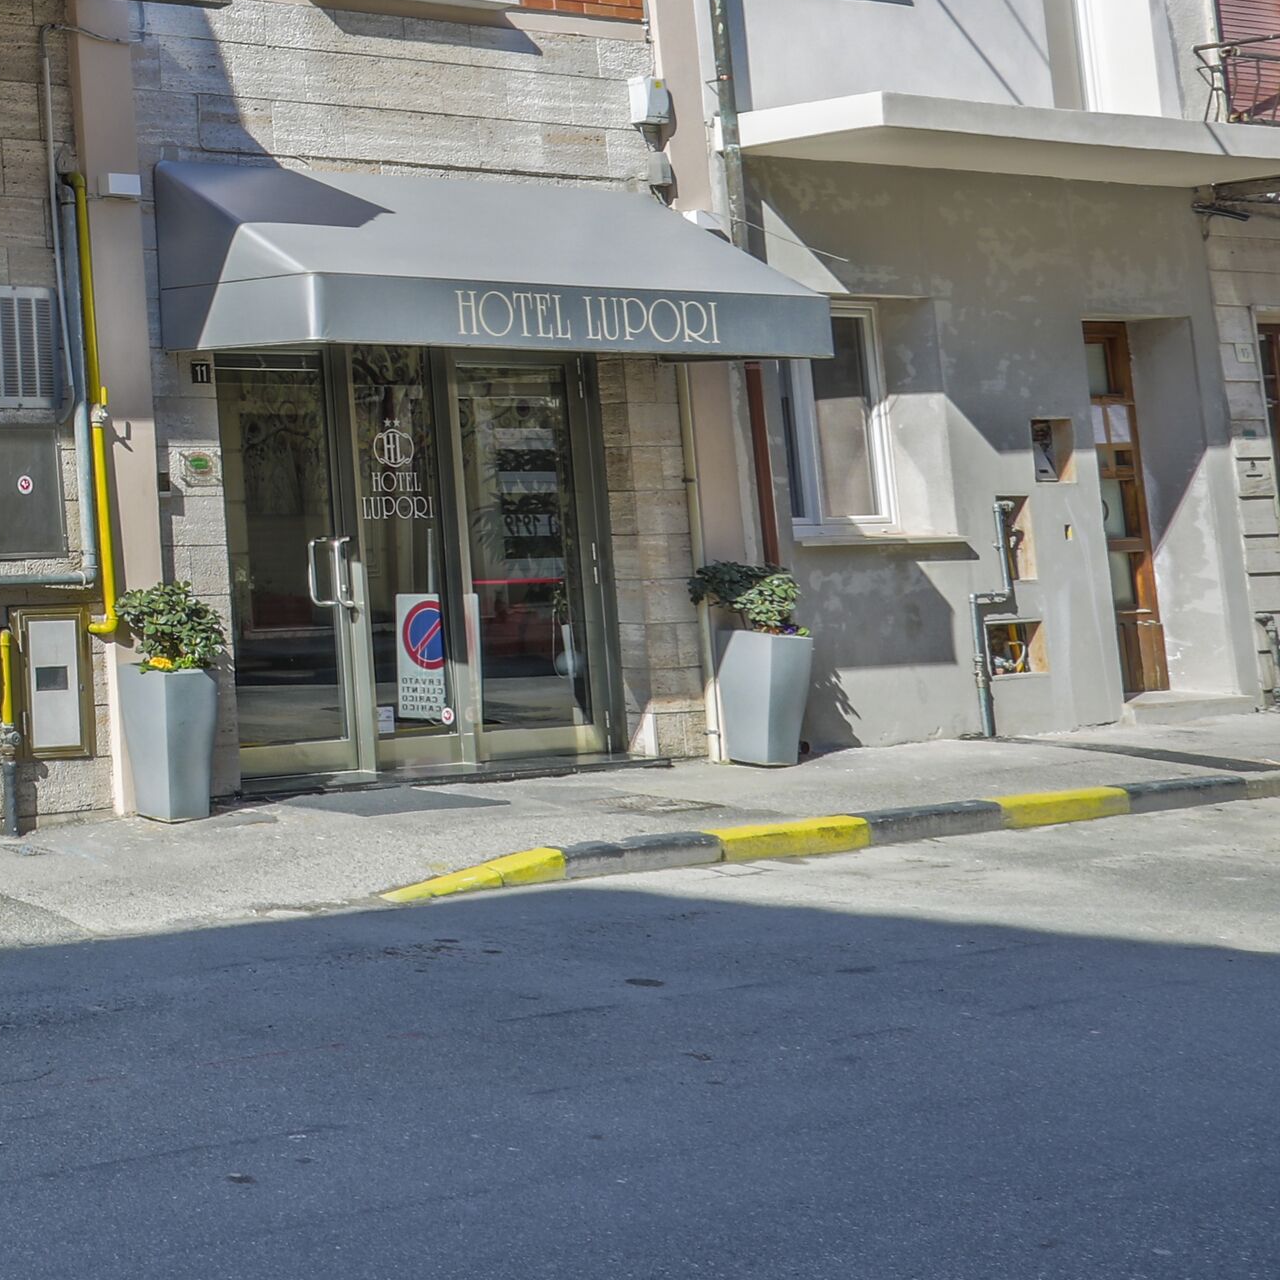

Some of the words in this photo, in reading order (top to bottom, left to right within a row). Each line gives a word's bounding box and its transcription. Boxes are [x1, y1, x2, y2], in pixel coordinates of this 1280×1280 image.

[454, 290, 572, 341] HOTEL
[582, 295, 721, 345] LUPORI
[195, 365, 208, 382] 11
[371, 471, 422, 492] HOTEL
[362, 496, 434, 520] LUPORI
